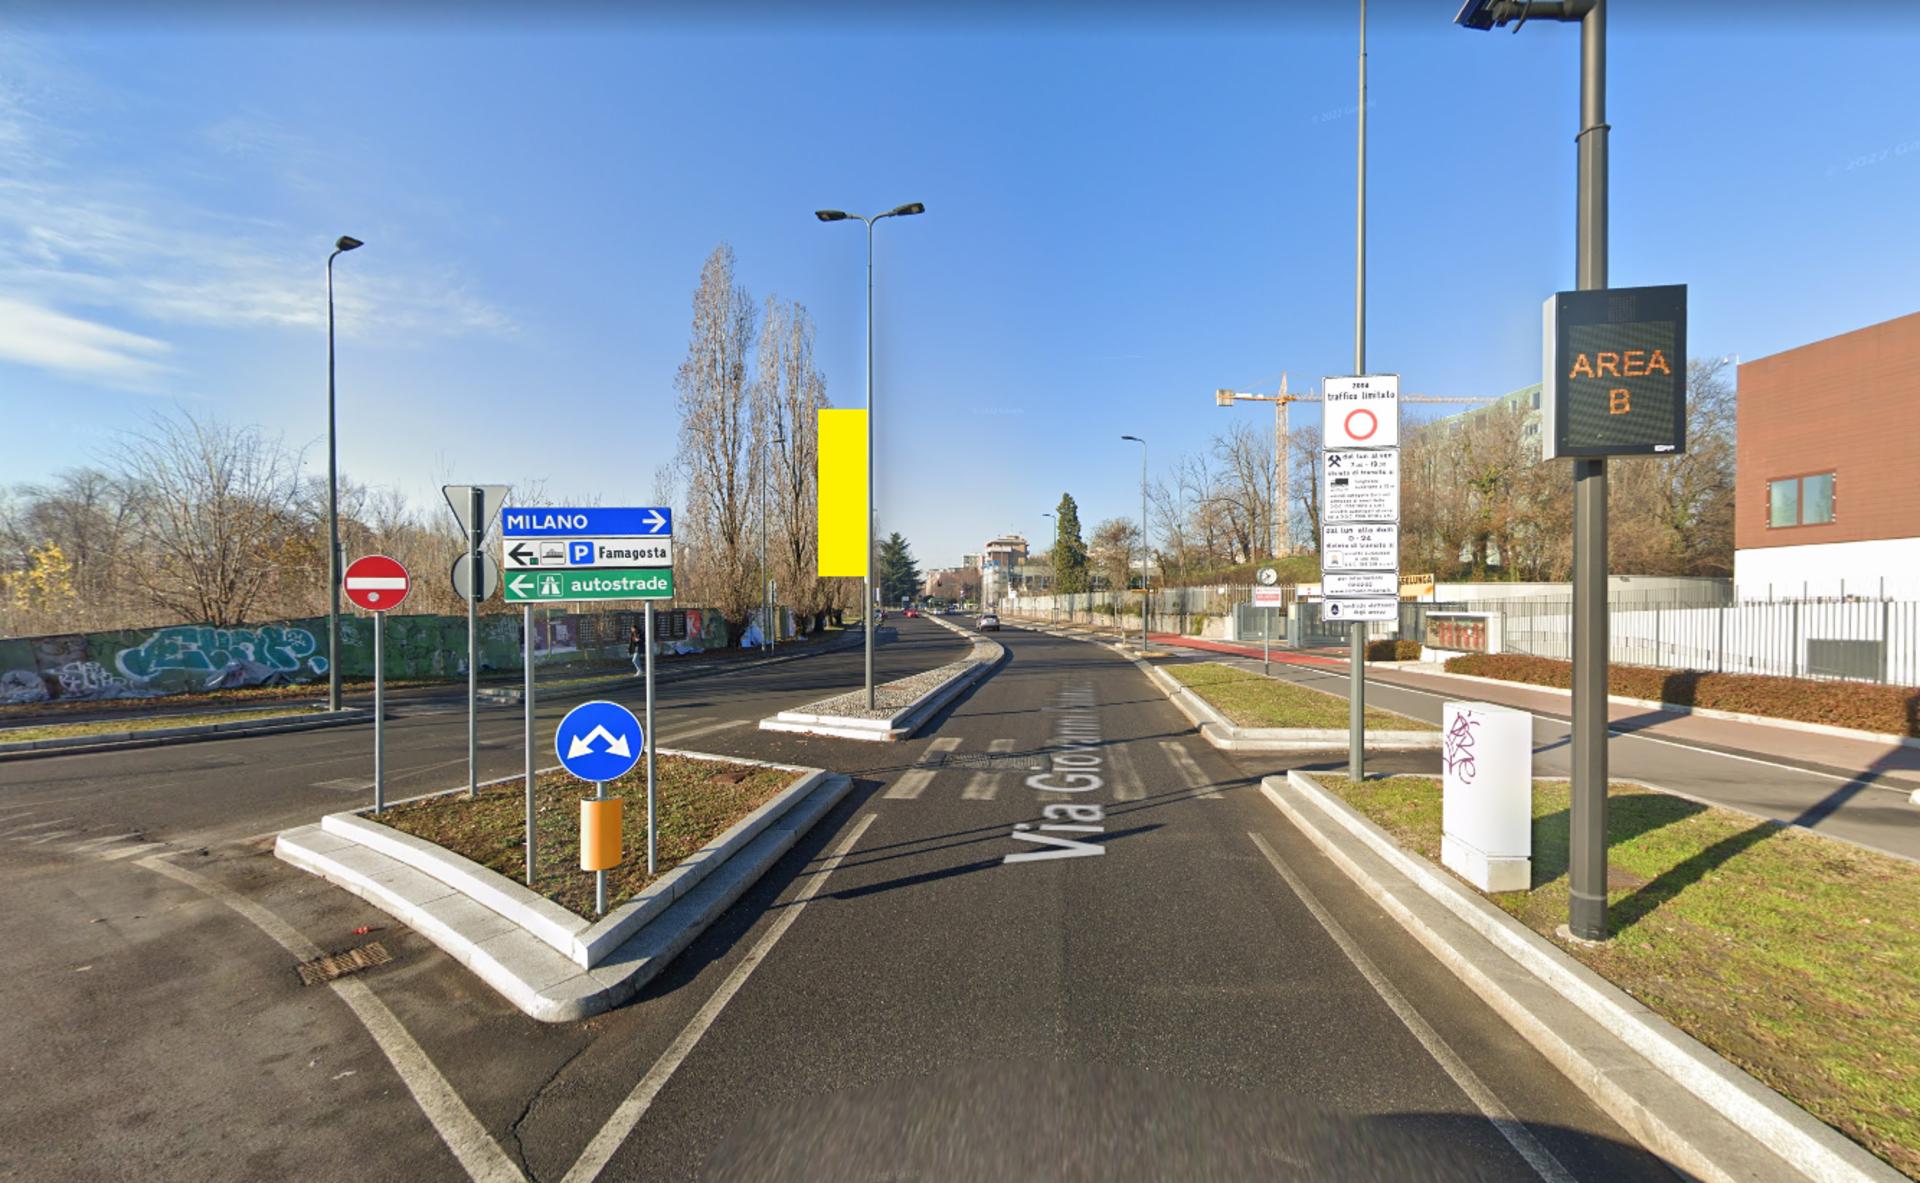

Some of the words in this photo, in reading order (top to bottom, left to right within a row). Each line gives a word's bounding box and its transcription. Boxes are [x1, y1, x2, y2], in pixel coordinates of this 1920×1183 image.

[1569, 350, 1671, 379] AREA
[1327, 391, 1358, 401] traffico
[1362, 390, 1396, 400] limitato
[1609, 388, 1632, 415] B
[507, 514, 588, 530] MILANO
[574, 545, 588, 561] P
[599, 546, 667, 563] Famagosta
[571, 576, 668, 592] autostrade
[1401, 575, 1433, 586] SELUNGA
